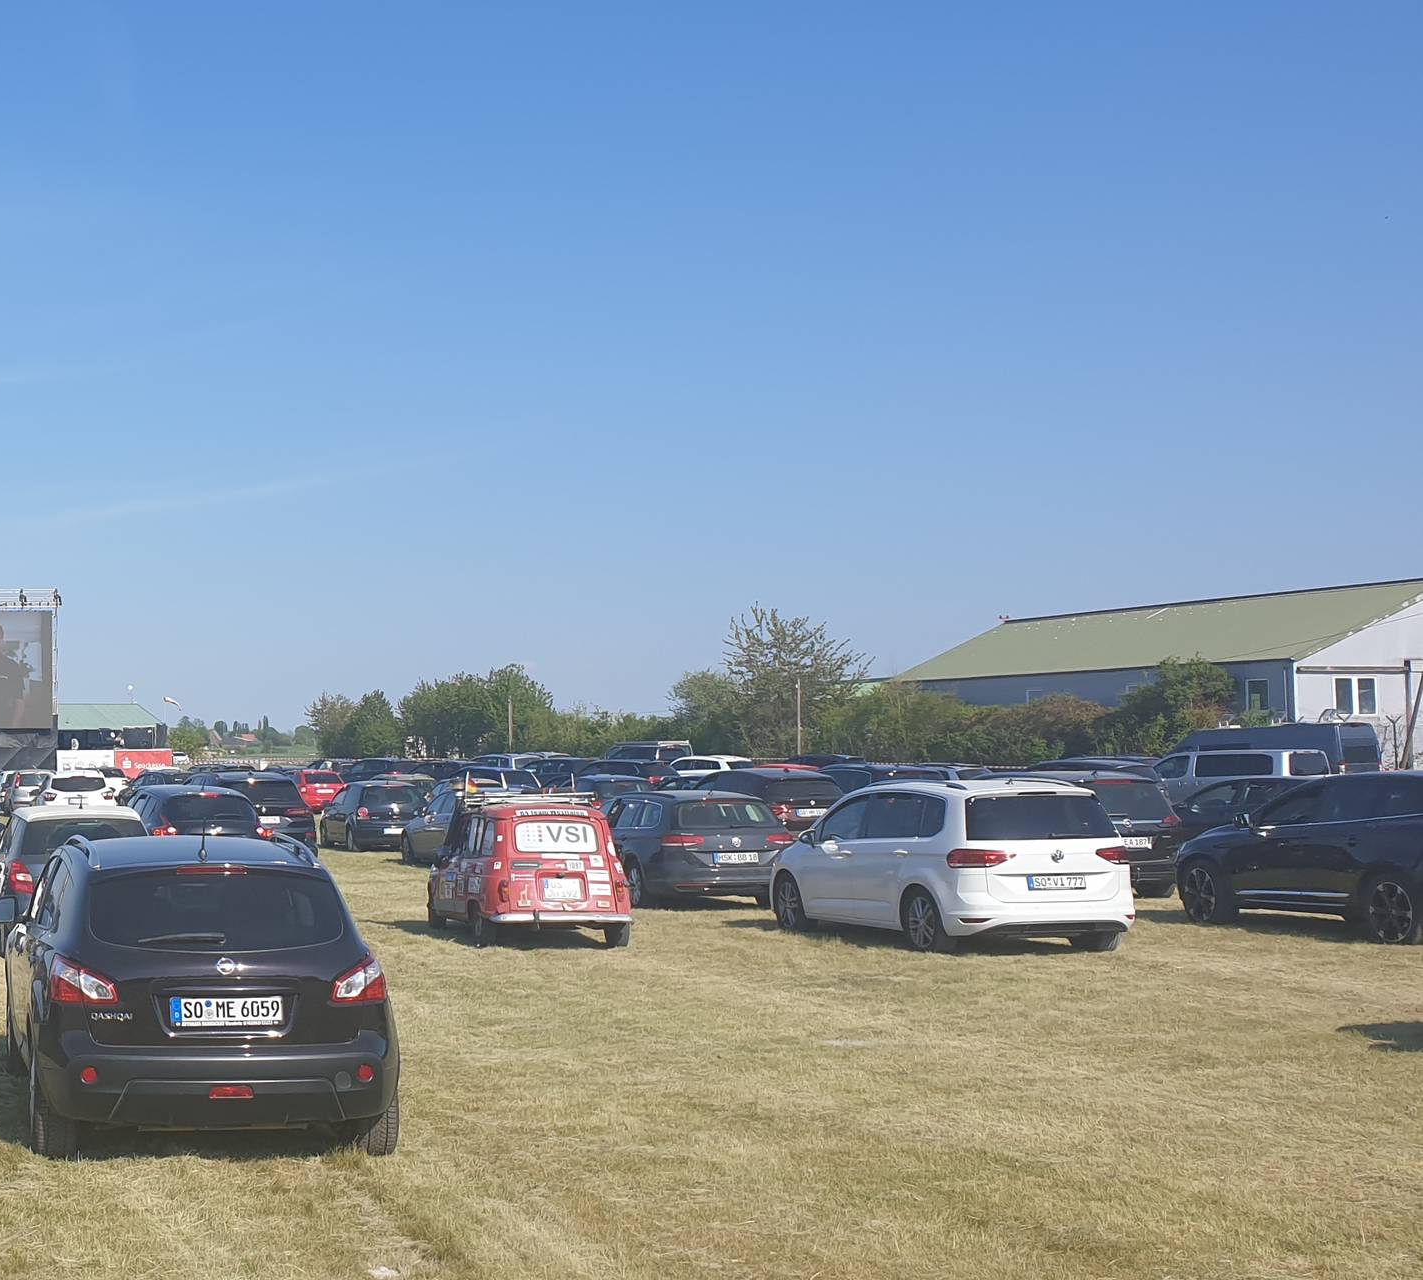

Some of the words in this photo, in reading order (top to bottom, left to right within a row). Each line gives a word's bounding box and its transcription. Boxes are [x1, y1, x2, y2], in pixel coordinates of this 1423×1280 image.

[546, 825, 588, 843] VSI
[1034, 877, 1047, 887] SO
[1066, 876, 1084, 886] 777
[183, 1001, 203, 1018] SO
[216, 1001, 235, 1018] ME
[241, 1000, 280, 1018] 6059
[90, 1012, 133, 1021] QASHQAI
